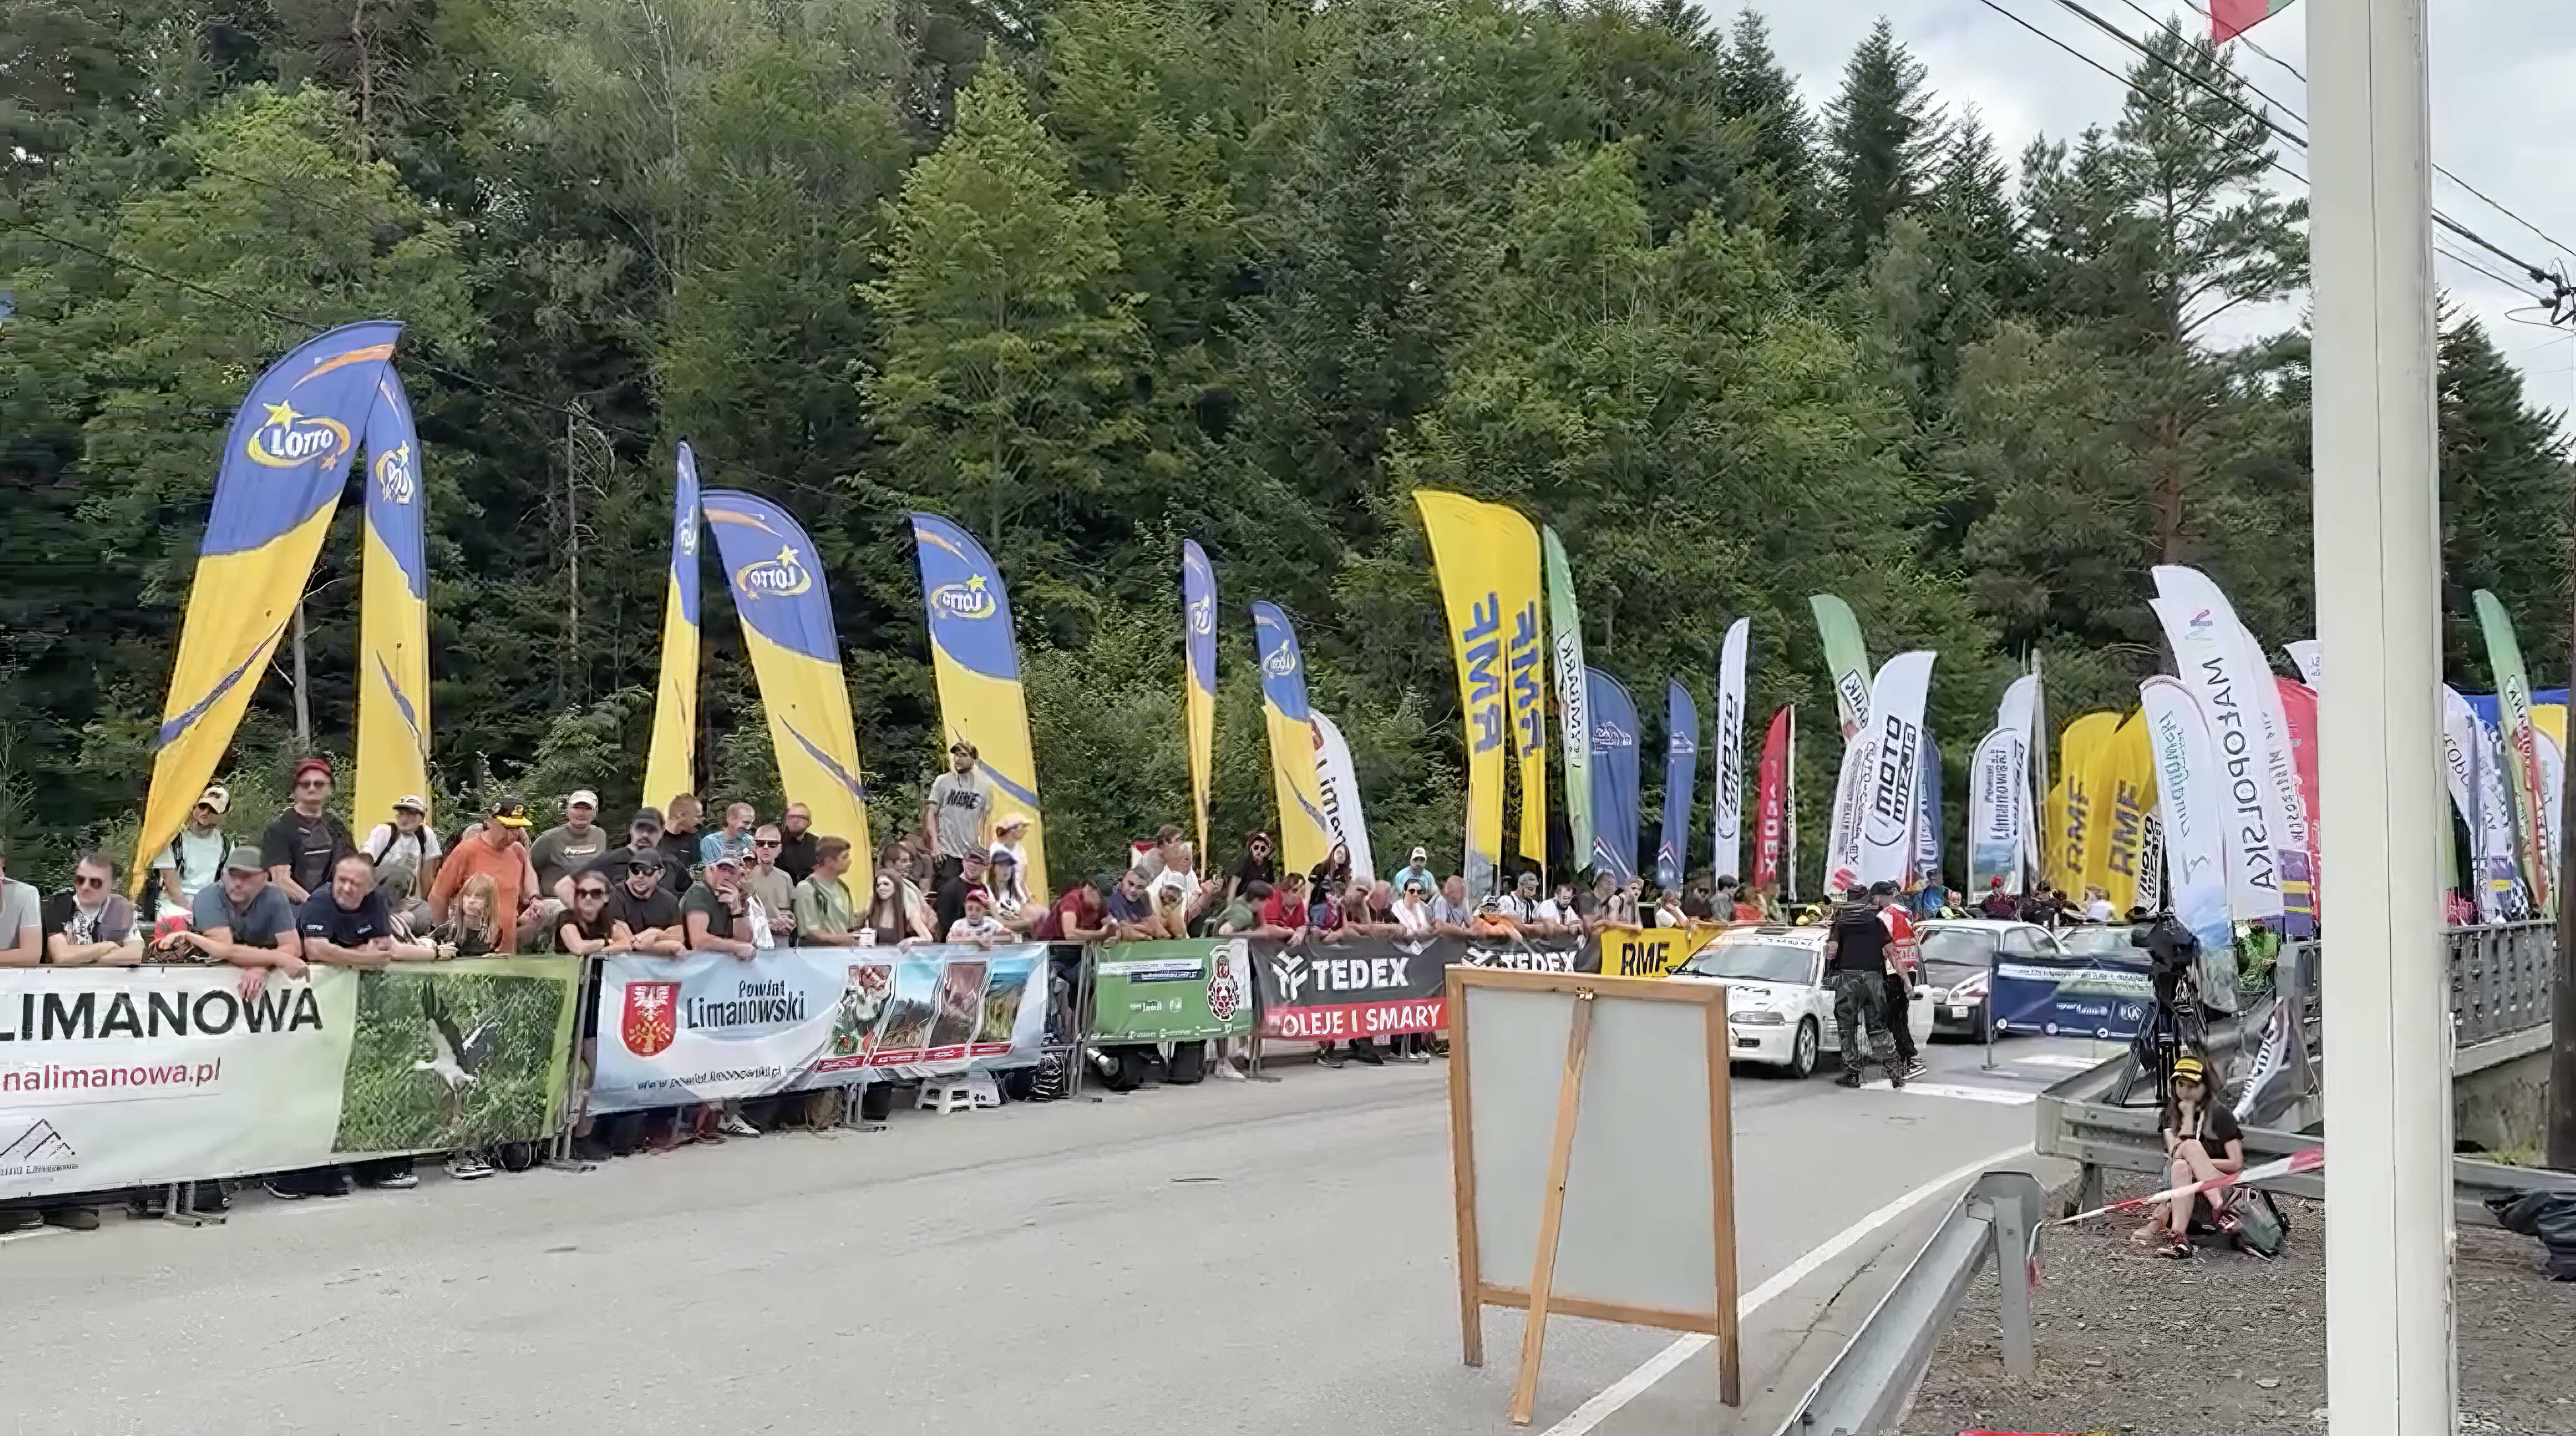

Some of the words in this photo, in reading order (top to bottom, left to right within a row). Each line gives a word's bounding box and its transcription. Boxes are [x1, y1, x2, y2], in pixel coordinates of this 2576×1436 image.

[270, 428, 334, 457] LOTTO
[1876, 714, 1902, 817] MOTO
[2065, 774, 2089, 875] RMF
[2108, 779, 2140, 878] RMF
[1312, 956, 1410, 991] TEDEX
[1621, 941, 1670, 977] RMF
[686, 990, 805, 1030] Limanowski
[1280, 1010, 1344, 1037] OLEJE
[1351, 1011, 1359, 1033] I
[1365, 1003, 1442, 1032] SMARY
[3, 1056, 221, 1092] nalimanowa.pl
